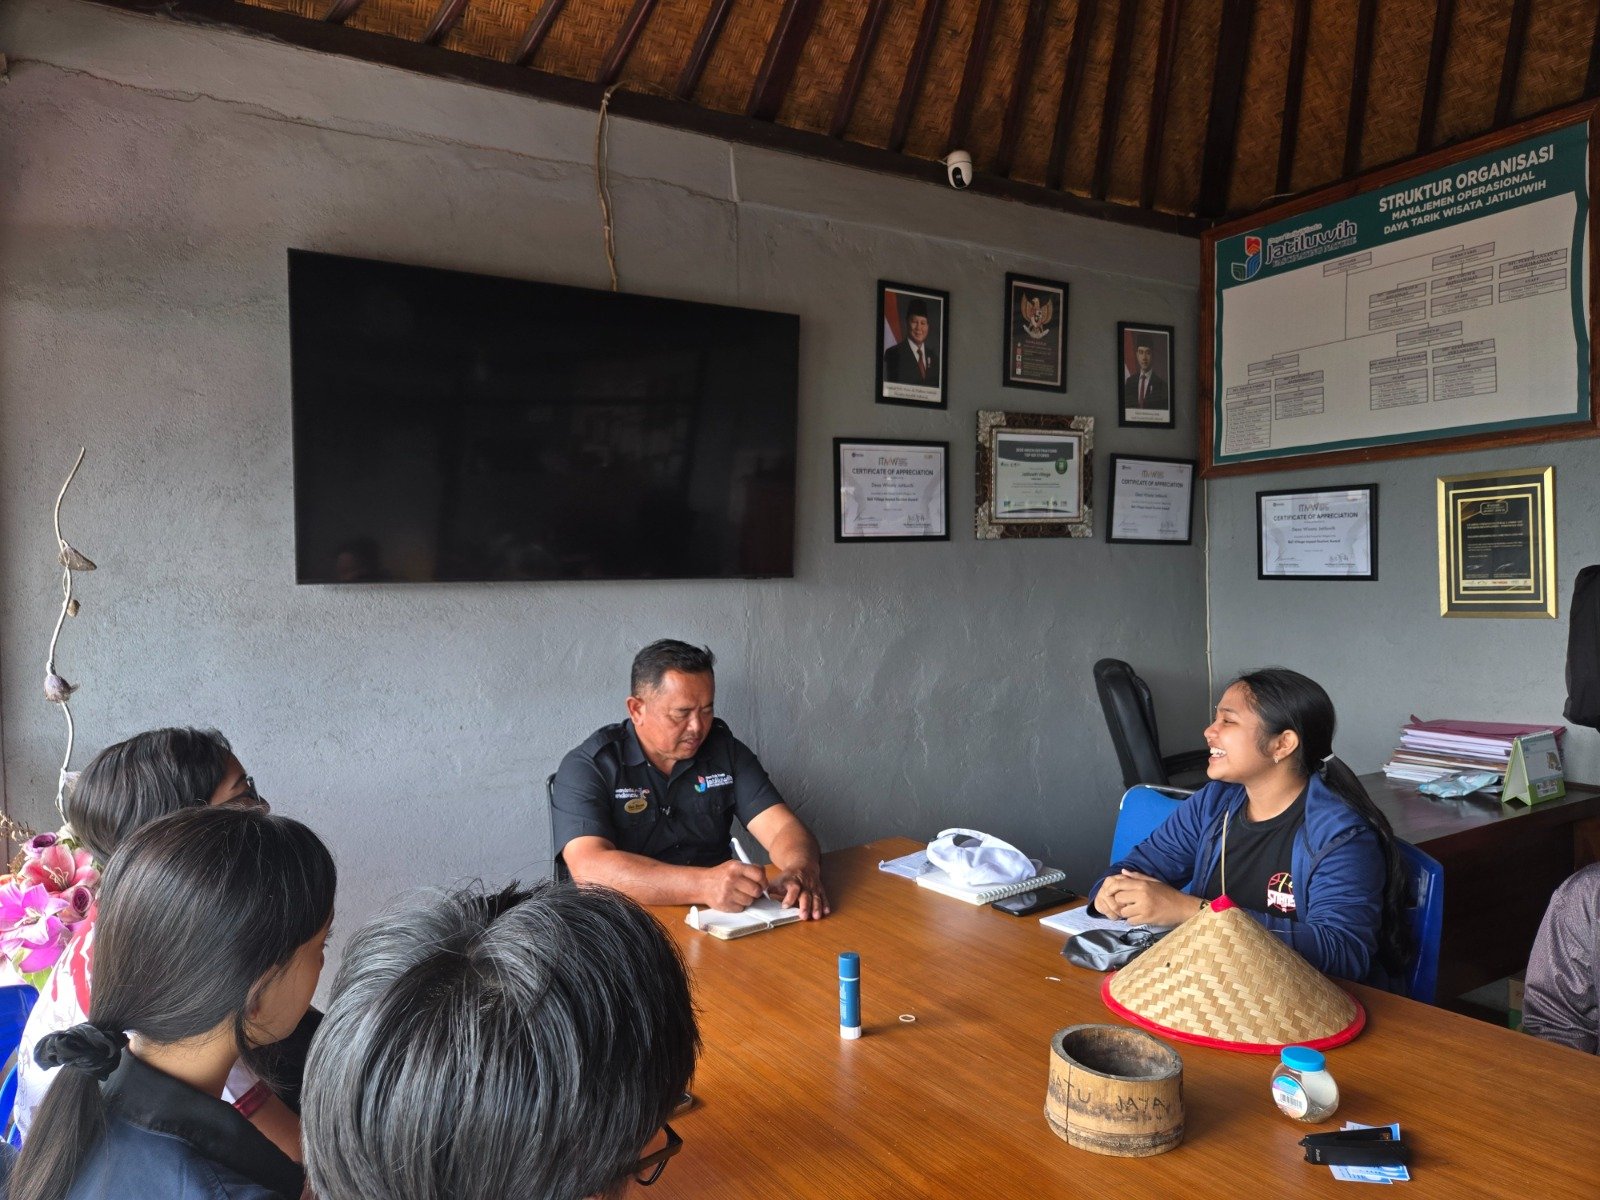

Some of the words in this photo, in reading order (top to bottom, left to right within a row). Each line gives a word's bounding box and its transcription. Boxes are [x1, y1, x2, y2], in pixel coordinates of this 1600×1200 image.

[1379, 178, 1452, 213] STRUKTUR
[1455, 144, 1554, 189] ORGANISASI
[1392, 195, 1455, 220] MANAJEMEN
[1457, 170, 1536, 201] OPERASIONAL
[1383, 221, 1409, 235] DAYA
[1411, 212, 1440, 227] TARIK
[1442, 199, 1483, 218] WISATA
[1485, 179, 1547, 206] JATILUWIH
[1265, 219, 1358, 265] Jatiluwih
[852, 468, 886, 476] CERTIFICATE
[1154, 480, 1183, 488] APPRECIATION
[1115, 1095, 1166, 1113] JAYA
